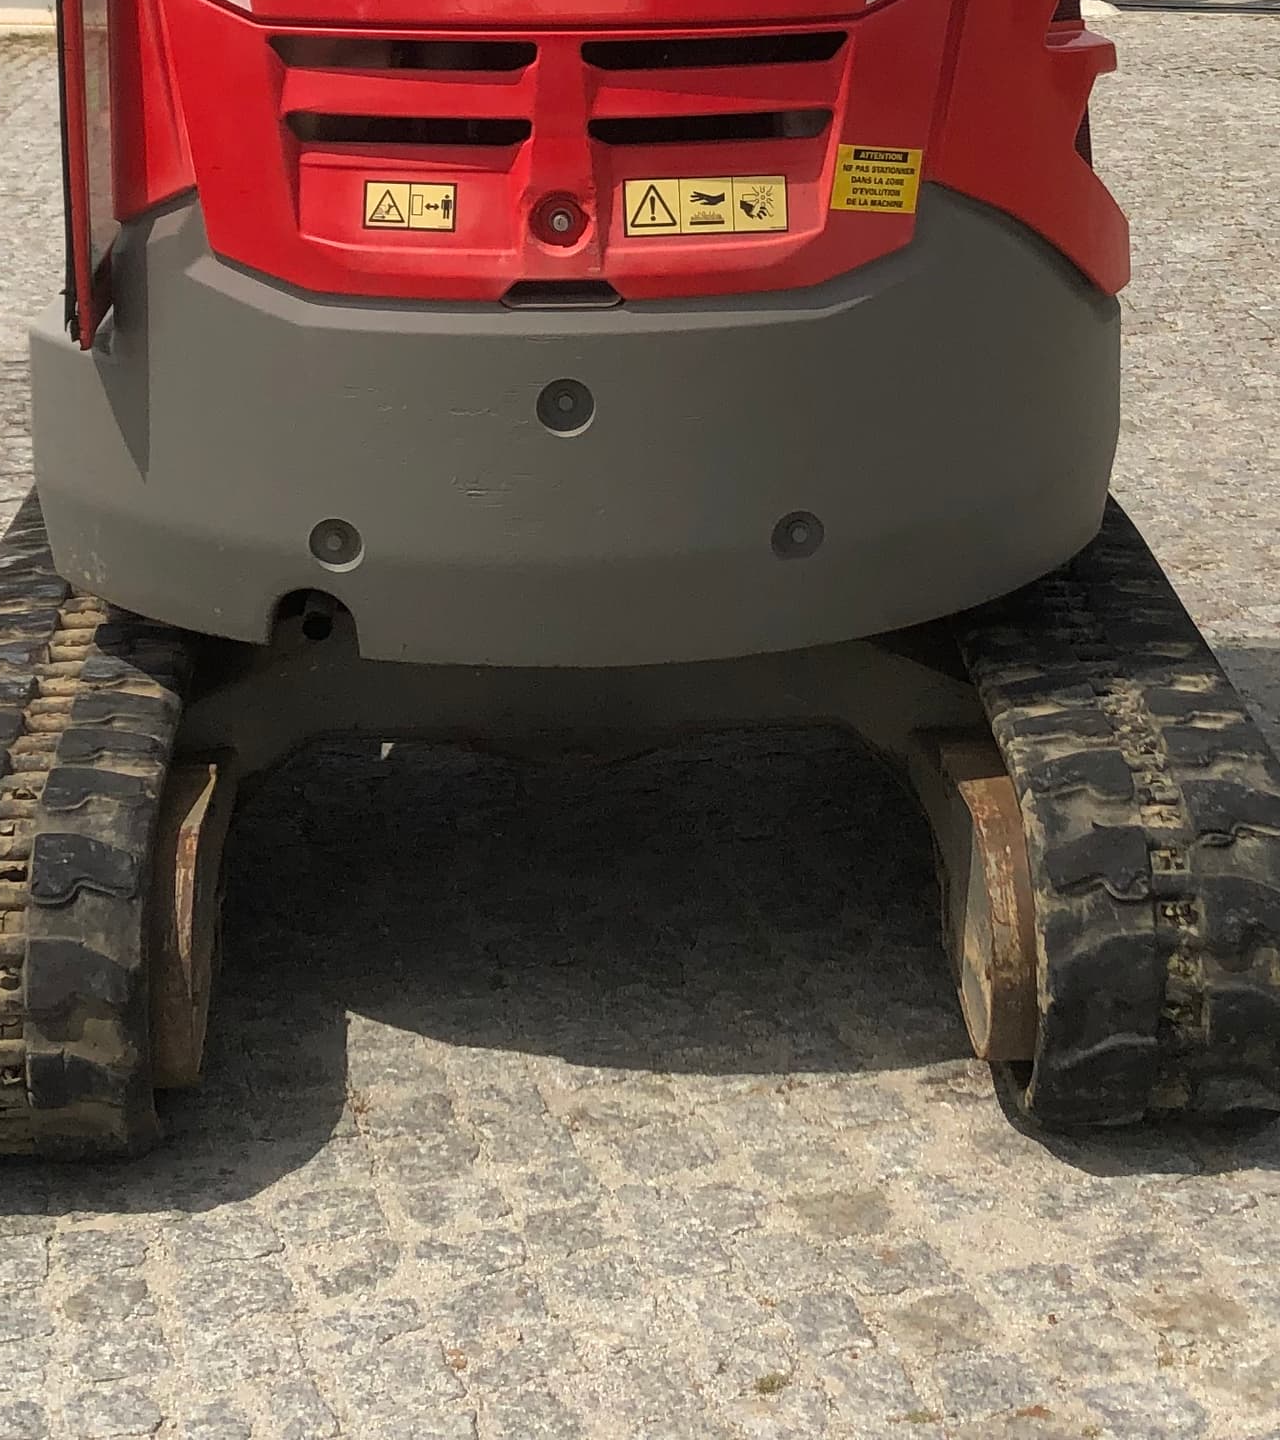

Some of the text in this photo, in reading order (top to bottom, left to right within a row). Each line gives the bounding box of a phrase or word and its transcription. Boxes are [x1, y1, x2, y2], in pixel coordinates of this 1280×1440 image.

[859, 151, 904, 161] ATTENTION
[855, 165, 870, 173] PAS
[871, 166, 915, 175] STATIONNER
[851, 176, 872, 184] DANS
[874, 177, 883, 185] LA
[858, 198, 869, 206] LA
[870, 199, 904, 208] MACHINE
